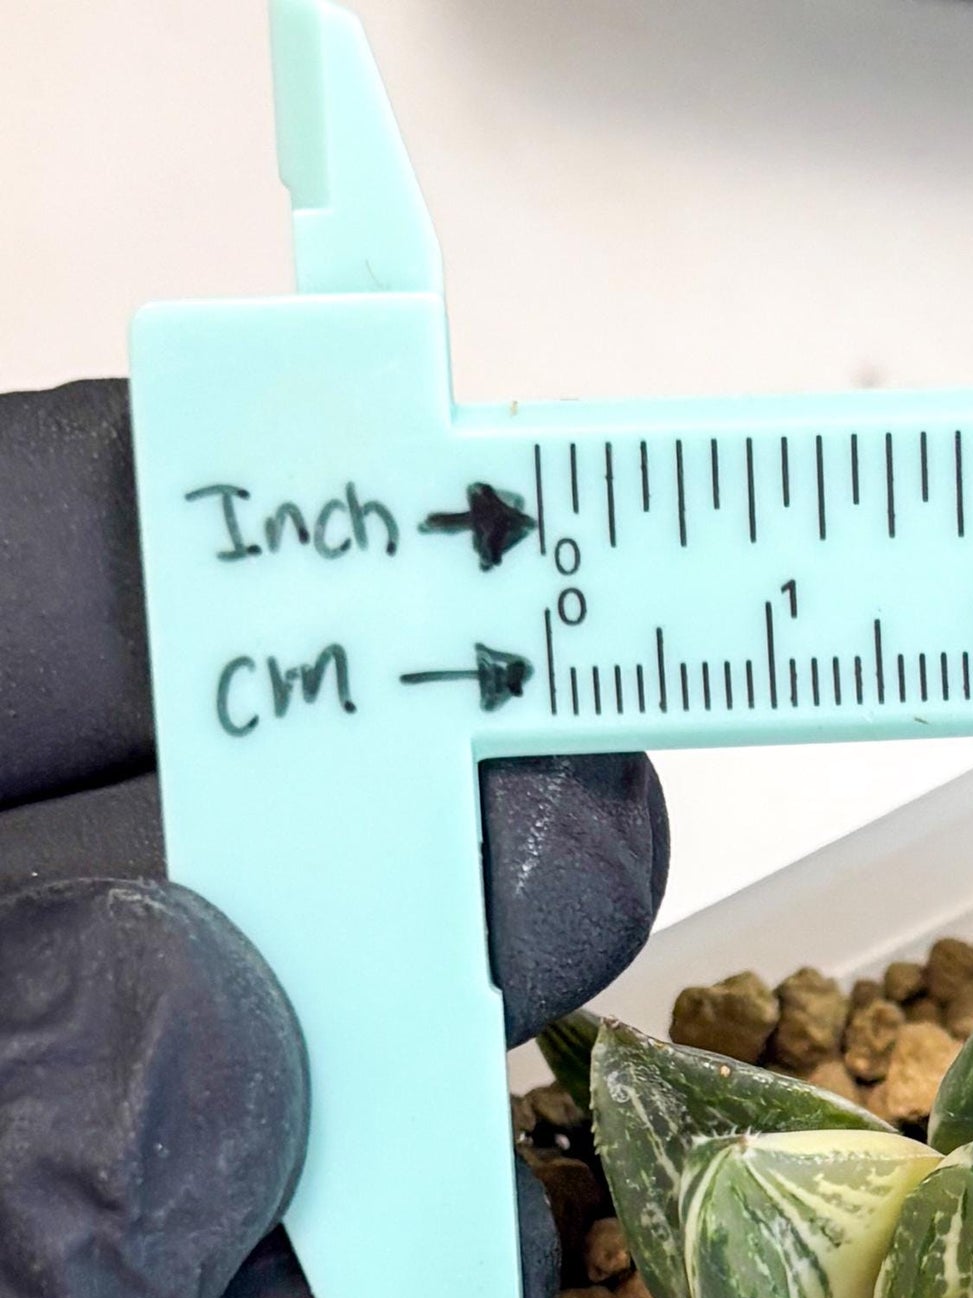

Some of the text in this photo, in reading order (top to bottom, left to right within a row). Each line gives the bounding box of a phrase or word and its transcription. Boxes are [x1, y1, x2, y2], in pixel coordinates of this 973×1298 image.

[183, 481, 400, 563] Inch
[553, 536, 582, 577] 0
[556, 586, 588, 627] 0
[780, 578, 798, 620] 1
